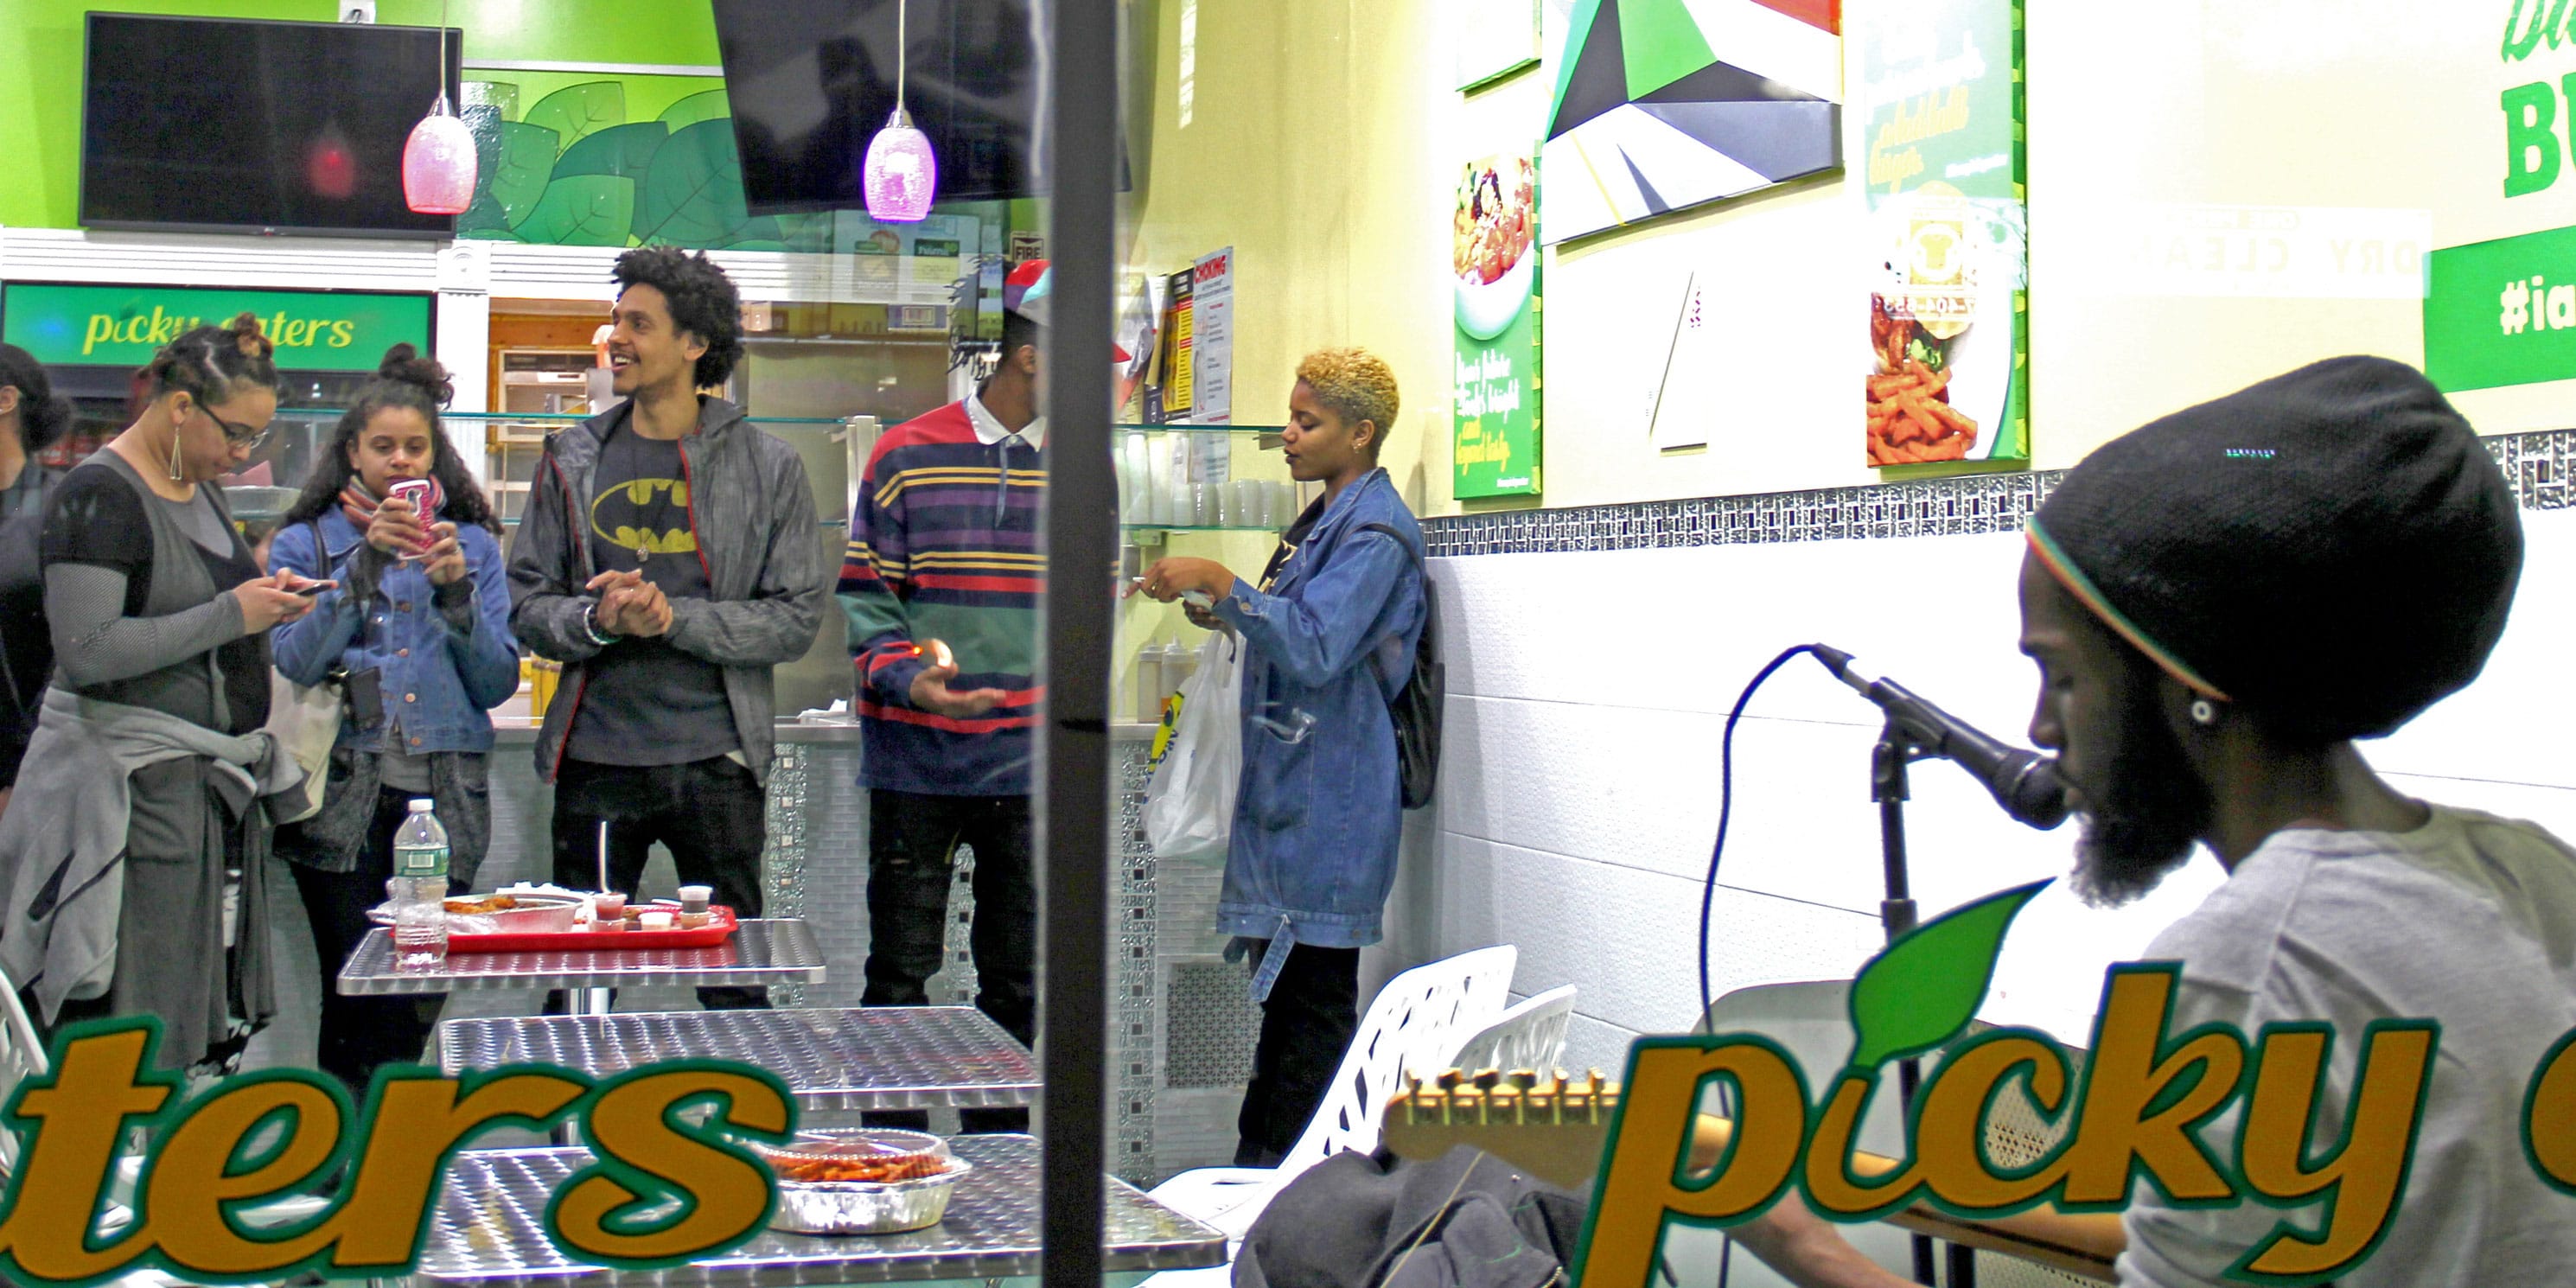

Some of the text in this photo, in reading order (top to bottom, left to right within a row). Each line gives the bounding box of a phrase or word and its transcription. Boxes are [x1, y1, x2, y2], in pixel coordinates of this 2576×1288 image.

[1016, 246, 1042, 259] FIRE
[220, 310, 355, 348] ters
[2500, 275, 2576, 335] #ia
[1569, 961, 2440, 1288] picky
